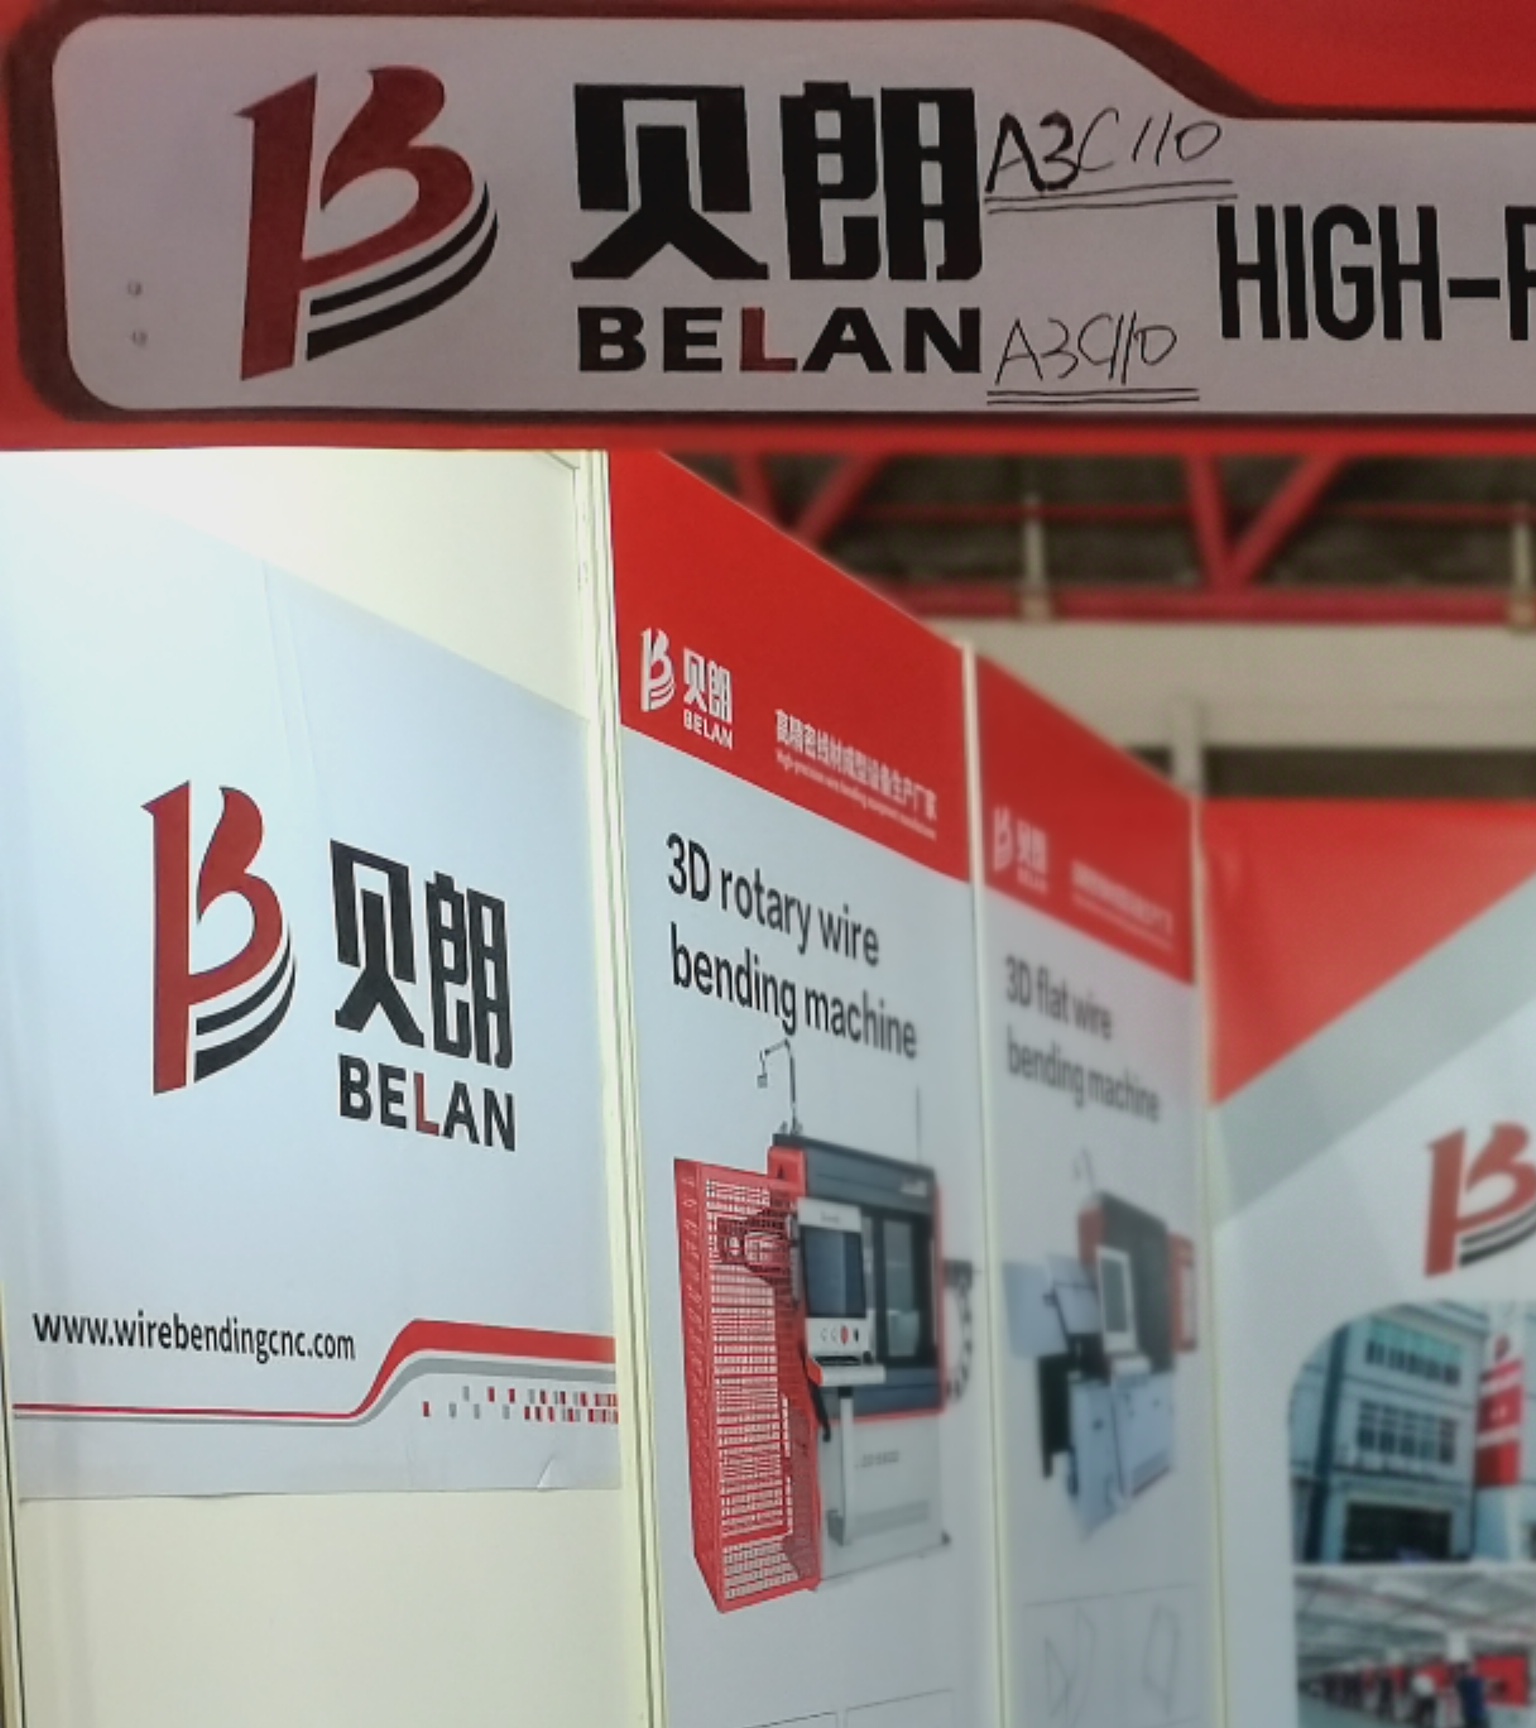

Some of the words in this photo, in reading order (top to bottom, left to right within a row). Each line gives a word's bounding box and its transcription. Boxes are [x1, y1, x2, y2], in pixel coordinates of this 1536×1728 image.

[571, 81, 983, 281] 贝朗
[577, 307, 981, 373] BELAN
[683, 648, 732, 724] 贝朗
[683, 709, 733, 749] BELAN
[666, 832, 711, 901] 3D
[721, 867, 812, 954] rotary
[820, 902, 880, 967] wire
[330, 838, 513, 1069] 贝朗
[671, 922, 796, 1035] bending
[804, 982, 918, 1059] machine
[1005, 952, 1031, 1007] 3D
[1037, 962, 1069, 1025] flat
[1071, 985, 1112, 1040] wire
[338, 1053, 516, 1153] BELAN
[1006, 1022, 1085, 1110] bending
[1086, 1065, 1160, 1123] machine
[33, 1309, 356, 1363] www.wirebendingcnc.com
